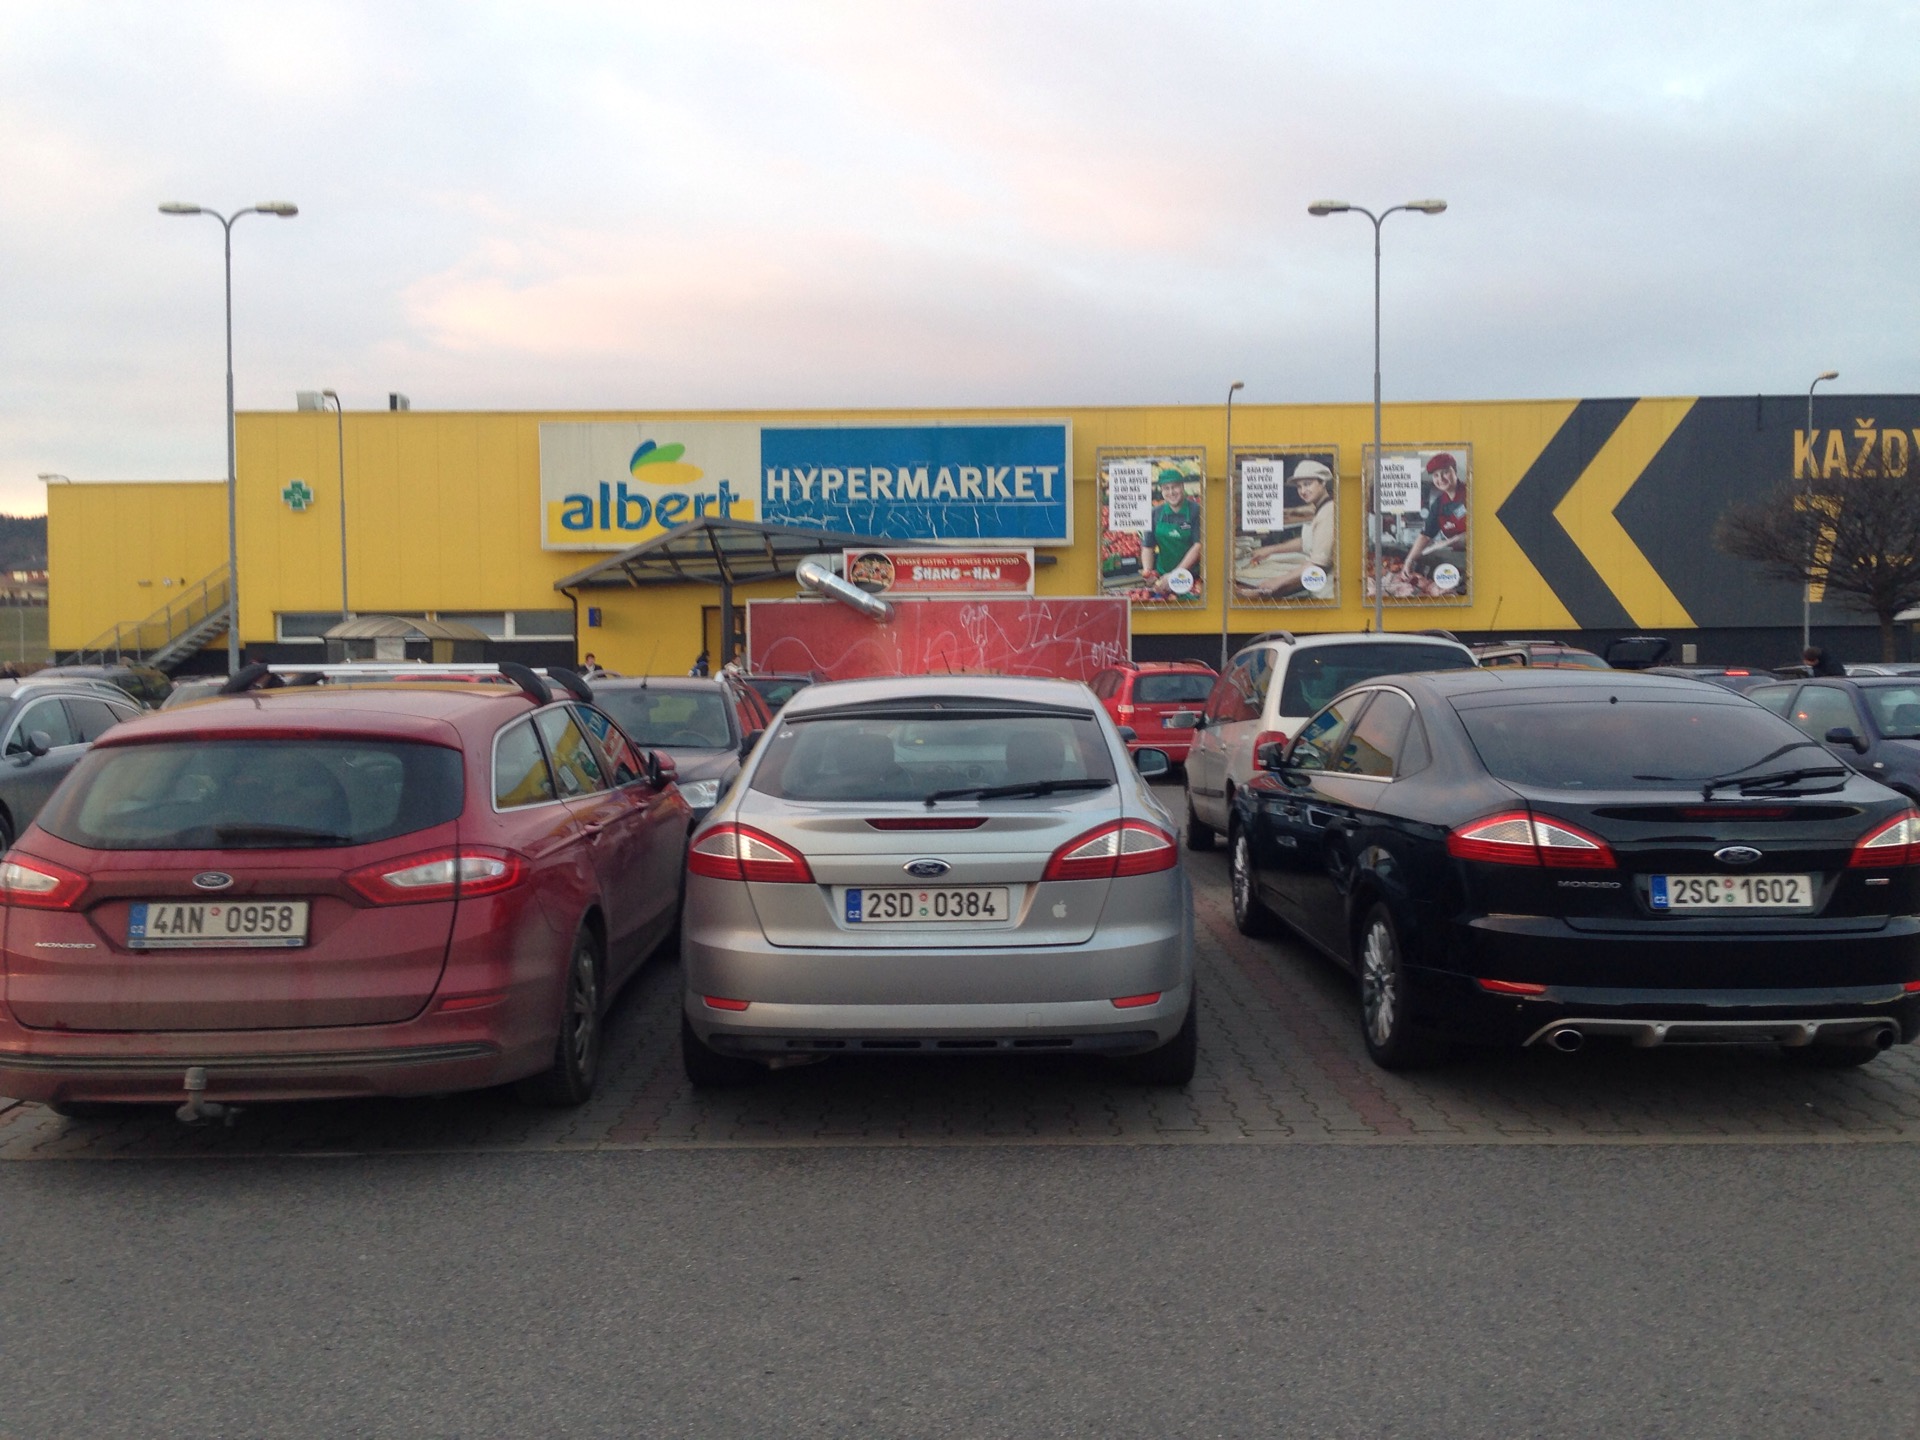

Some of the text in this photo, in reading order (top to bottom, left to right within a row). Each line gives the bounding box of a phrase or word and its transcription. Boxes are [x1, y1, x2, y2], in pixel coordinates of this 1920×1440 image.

[1262, 466, 1274, 474] PRO
[1128, 477, 1148, 485] ABYSTE
[1247, 474, 1257, 482] VÁS
[561, 465, 1060, 531] albert HYPERMARKET
[1247, 491, 1264, 499] DENNĚ
[1394, 490, 1407, 498] VÁM
[1114, 502, 1138, 510] ČERSTVÉ
[922, 558, 947, 566] BISTRO
[952, 558, 981, 566] CHINESE
[983, 557, 1019, 566] FASTFOOD
[914, 864, 940, 875] Ford
[1557, 880, 1622, 889] MONDEO
[1673, 878, 1799, 904] 2SC 1602
[1654, 895, 1667, 904] CZ
[868, 892, 995, 918] 2SD 0384
[848, 910, 860, 919] CZ
[153, 905, 293, 934] 4AN 0958
[130, 925, 144, 935] CZ
[34, 941, 97, 950] MONDEO
